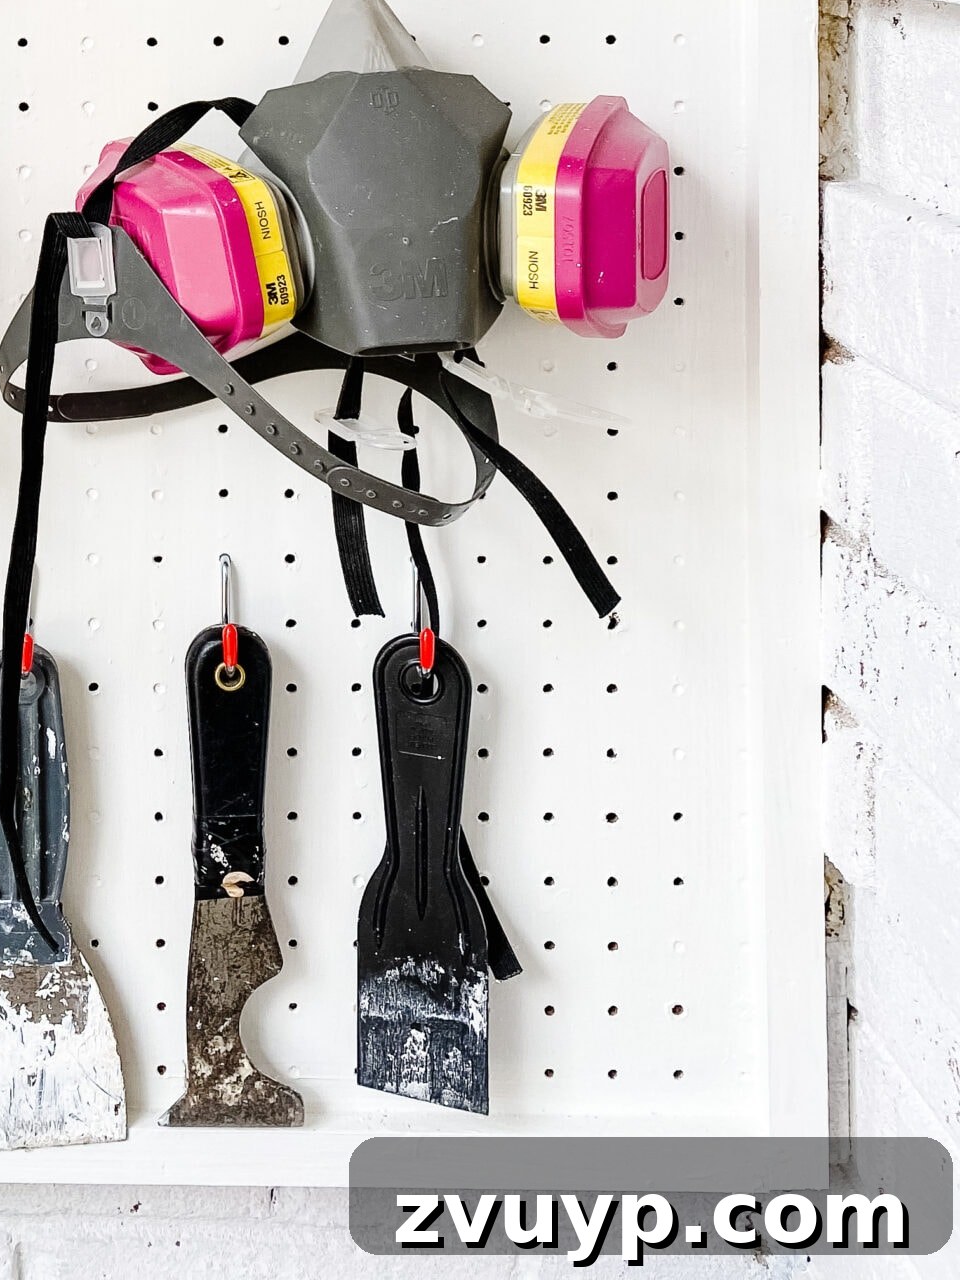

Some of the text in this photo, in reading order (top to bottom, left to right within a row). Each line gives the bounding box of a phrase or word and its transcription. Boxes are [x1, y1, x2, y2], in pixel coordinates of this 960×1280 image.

[523, 186, 532, 216] 60923
[536, 189, 546, 211] 3M
[255, 201, 271, 240] NIOSH
[370, 259, 448, 301] 3M
[528, 251, 539, 289] NIOSH
[266, 282, 278, 305] 3M
[277, 275, 289, 305] 60923
